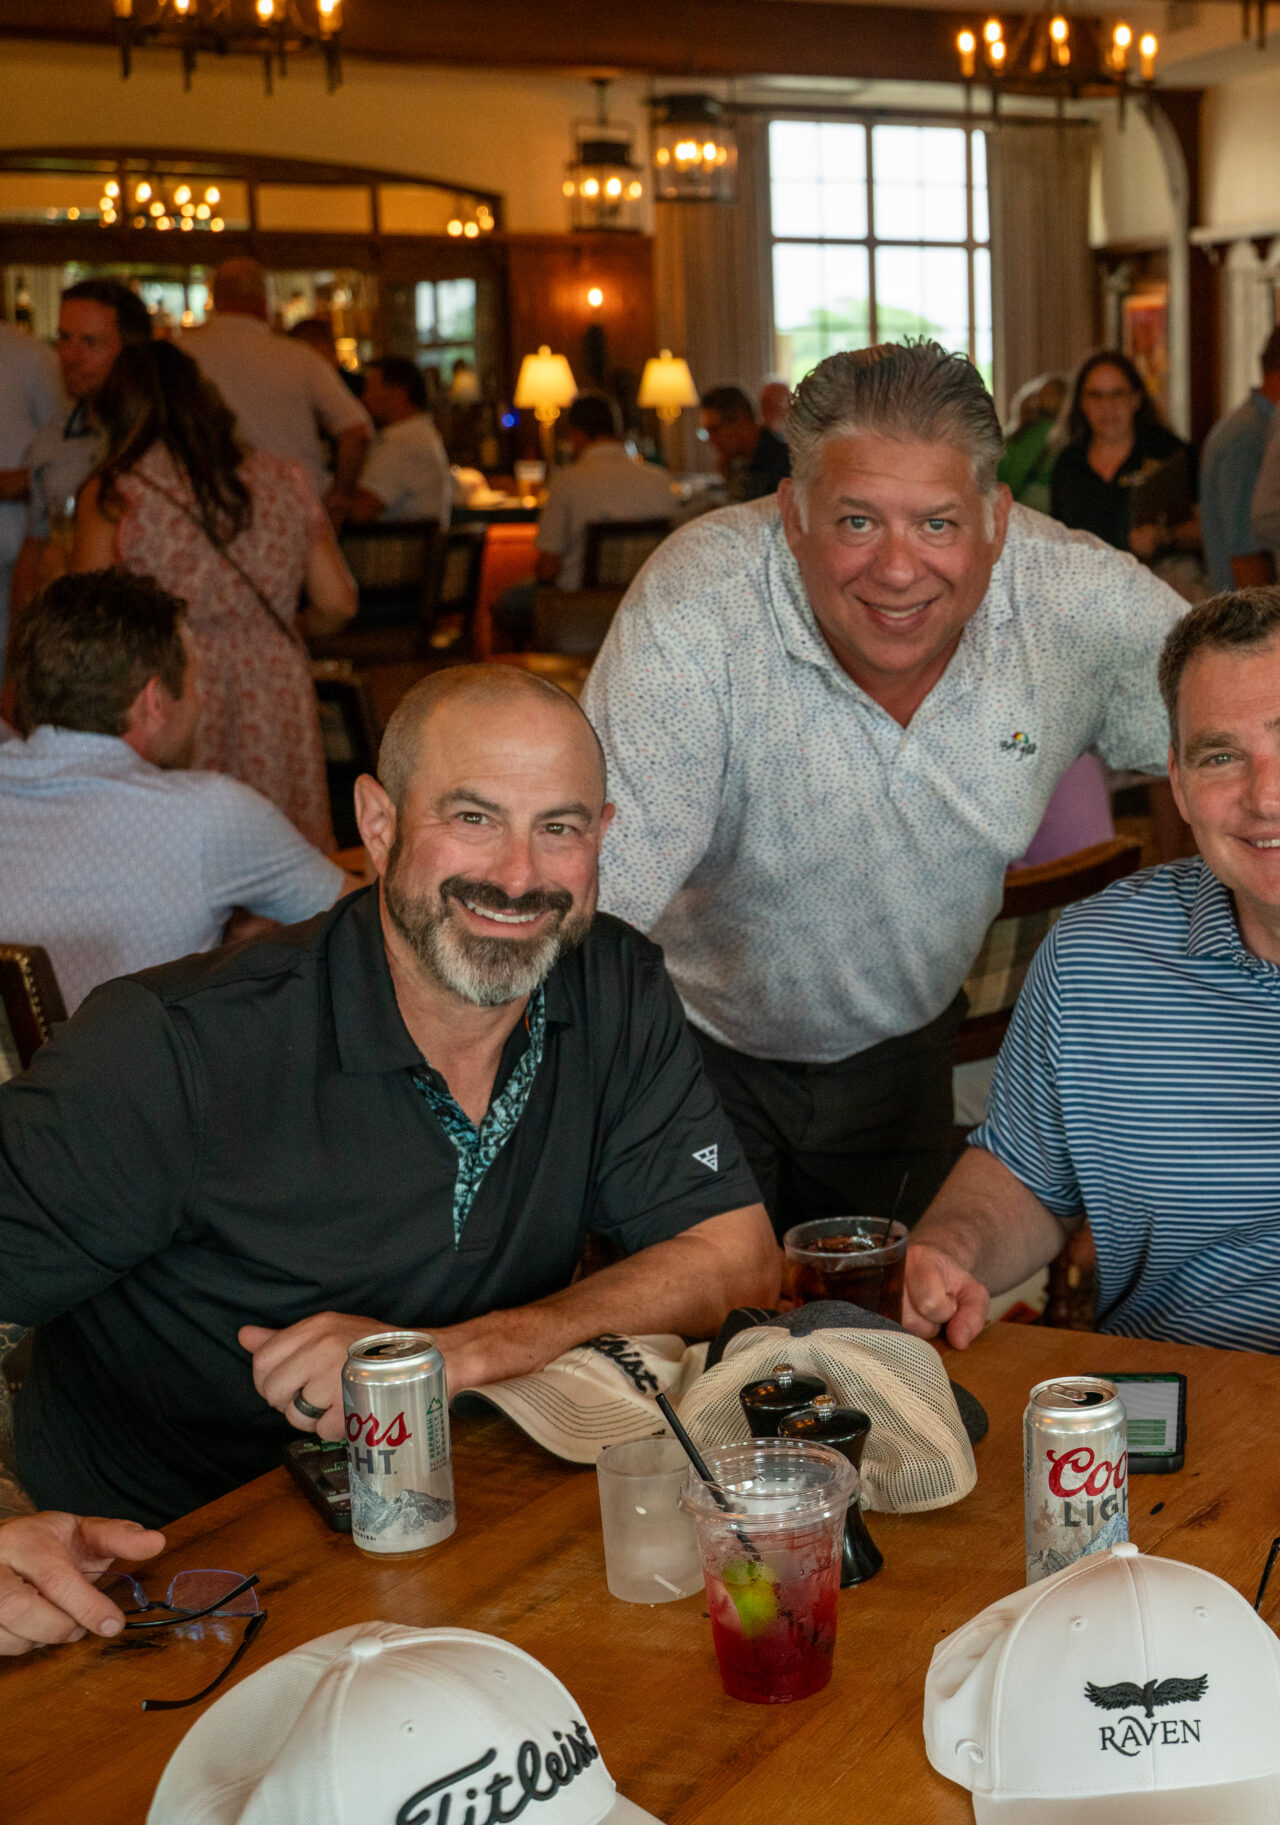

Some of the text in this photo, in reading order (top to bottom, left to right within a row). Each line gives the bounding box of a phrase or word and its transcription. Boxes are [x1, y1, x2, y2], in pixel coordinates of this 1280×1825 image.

[345, 1411, 413, 1447] ors
[1046, 1447, 1128, 1498] Coo
[1098, 1715, 1201, 1757] RAVEN
